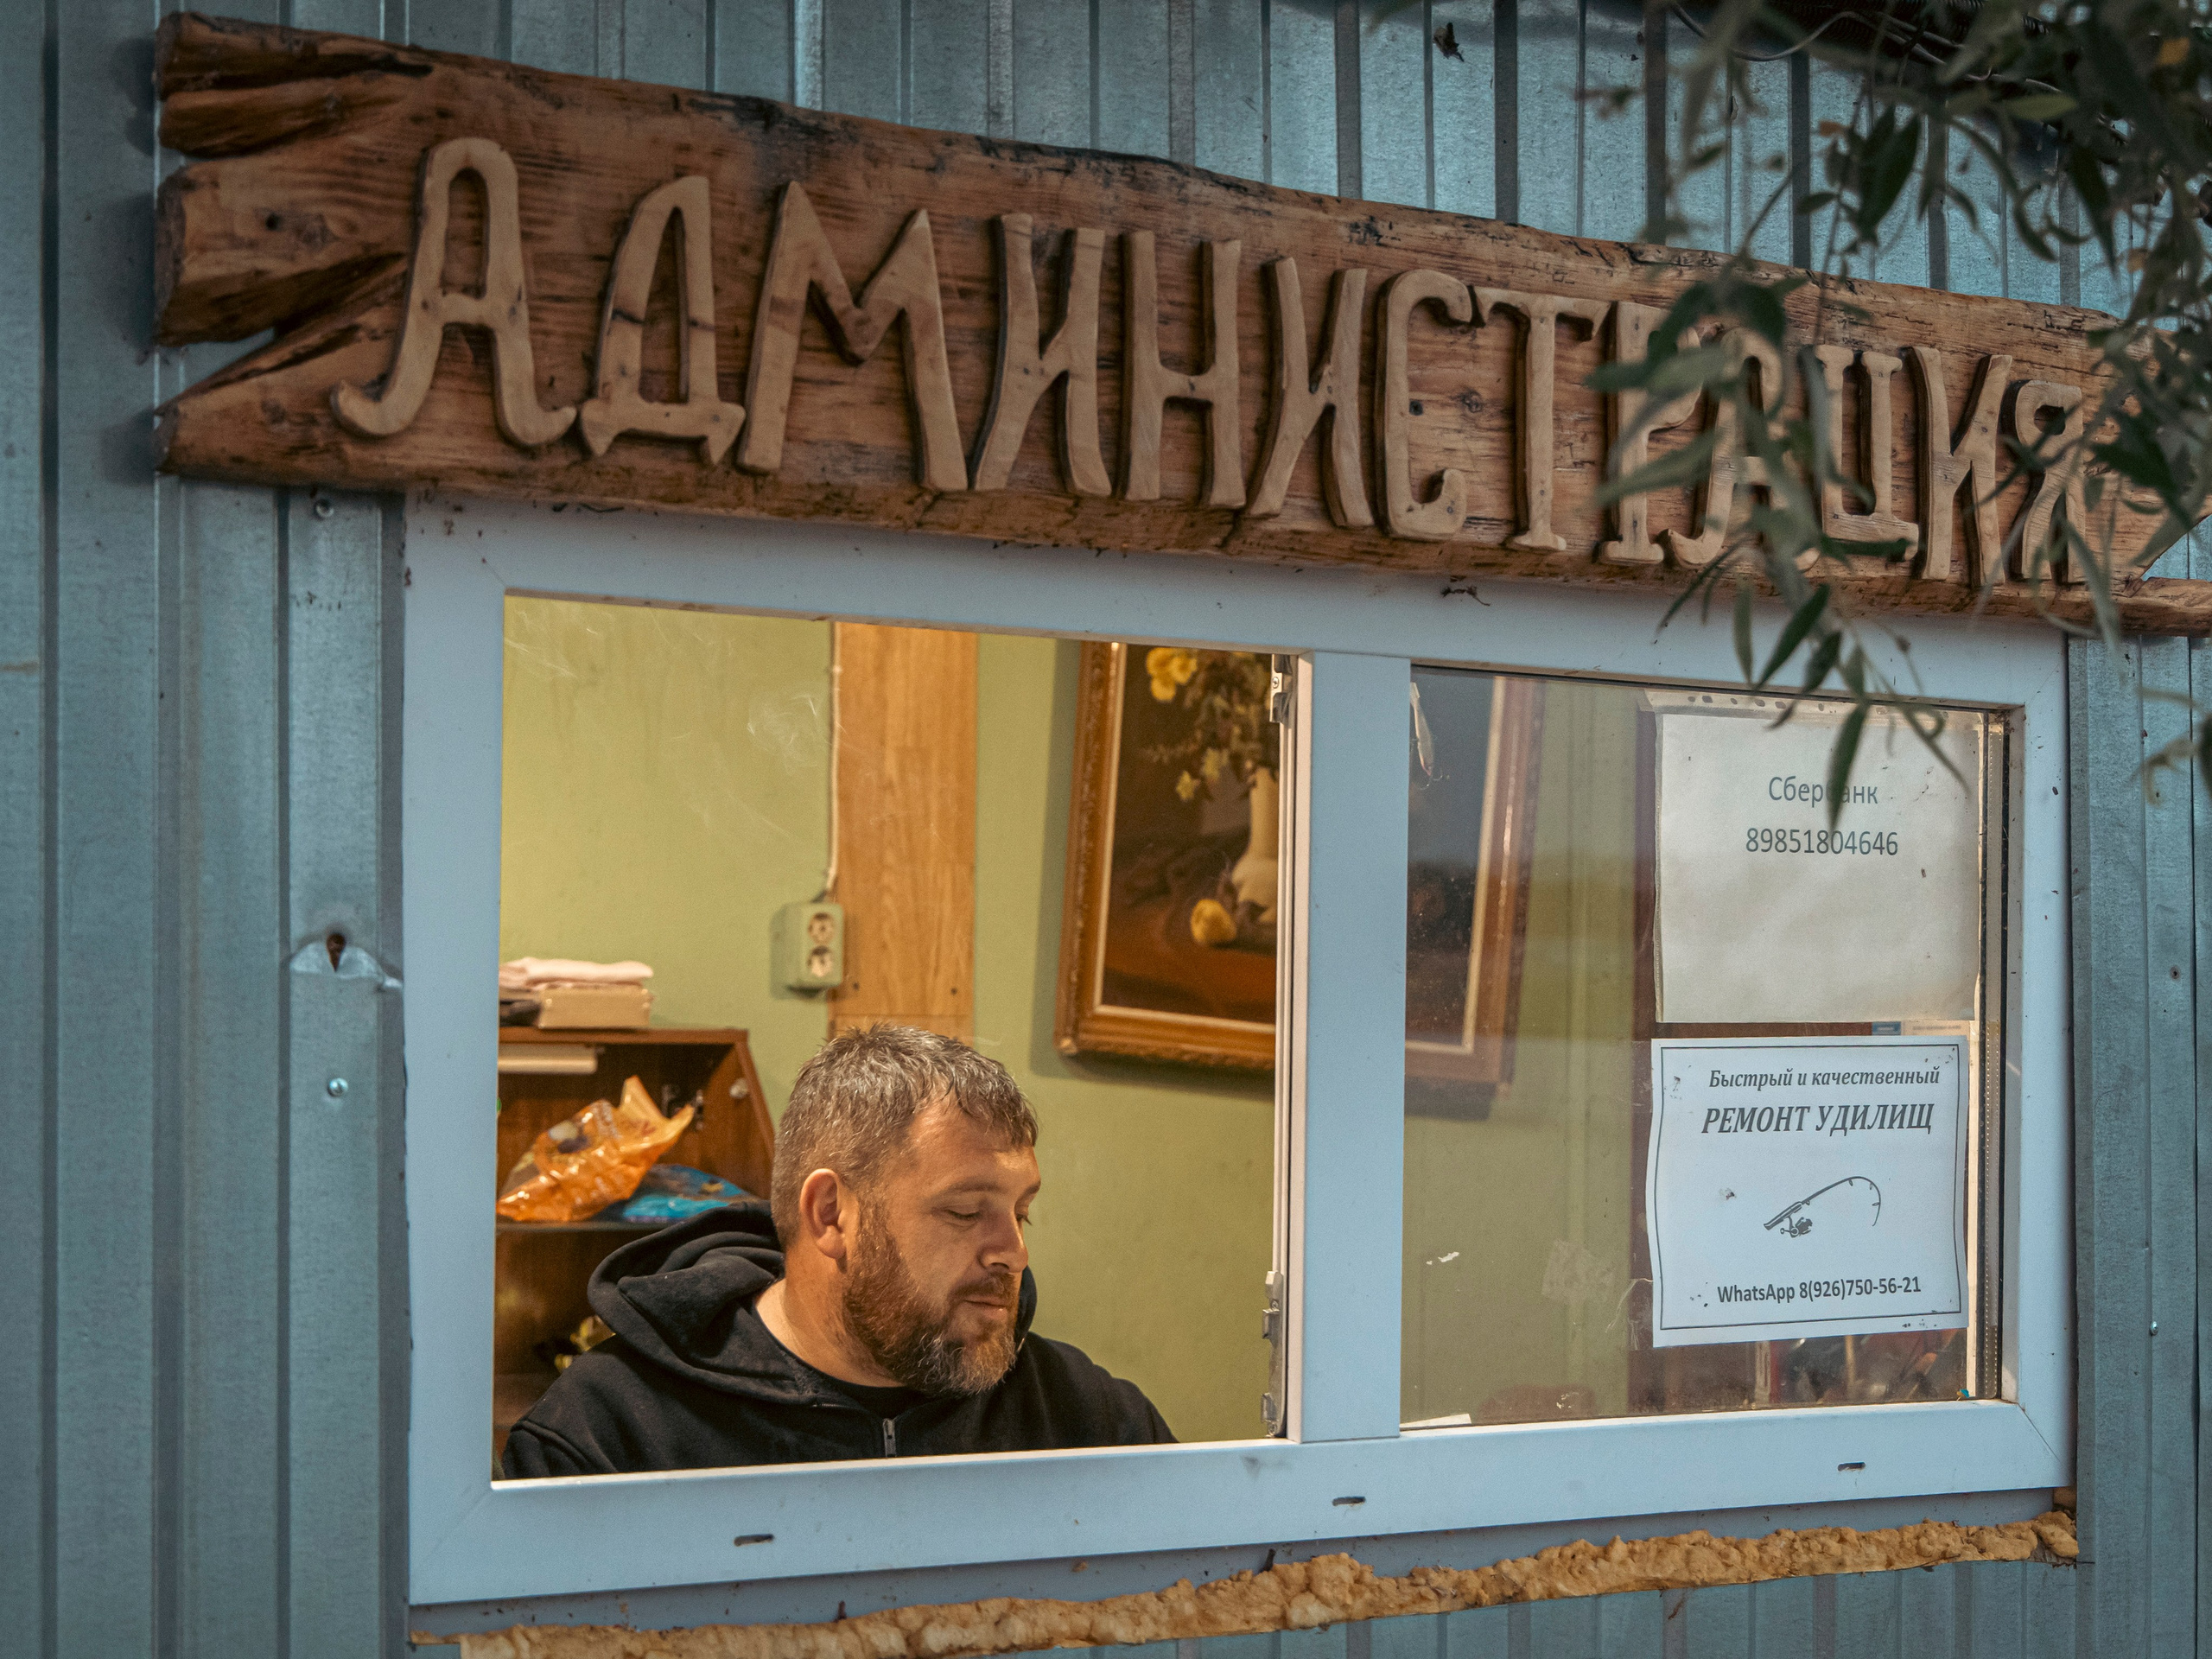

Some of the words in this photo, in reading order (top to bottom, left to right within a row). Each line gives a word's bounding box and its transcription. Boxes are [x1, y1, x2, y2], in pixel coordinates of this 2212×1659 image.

[1745, 827, 1898, 856] 89851804646
[1708, 1068, 1793, 1090] Быстрый
[1797, 1072, 1807, 1087] и
[1811, 1065, 1941, 1087] качественный
[1701, 1105, 1811, 1134] РЕМОНТ
[1815, 1103, 1936, 1137] УДИЛИЩ
[1717, 1282, 1796, 1304] WhatsApp
[1799, 1275, 1922, 1302] 8(926)750-56-21
